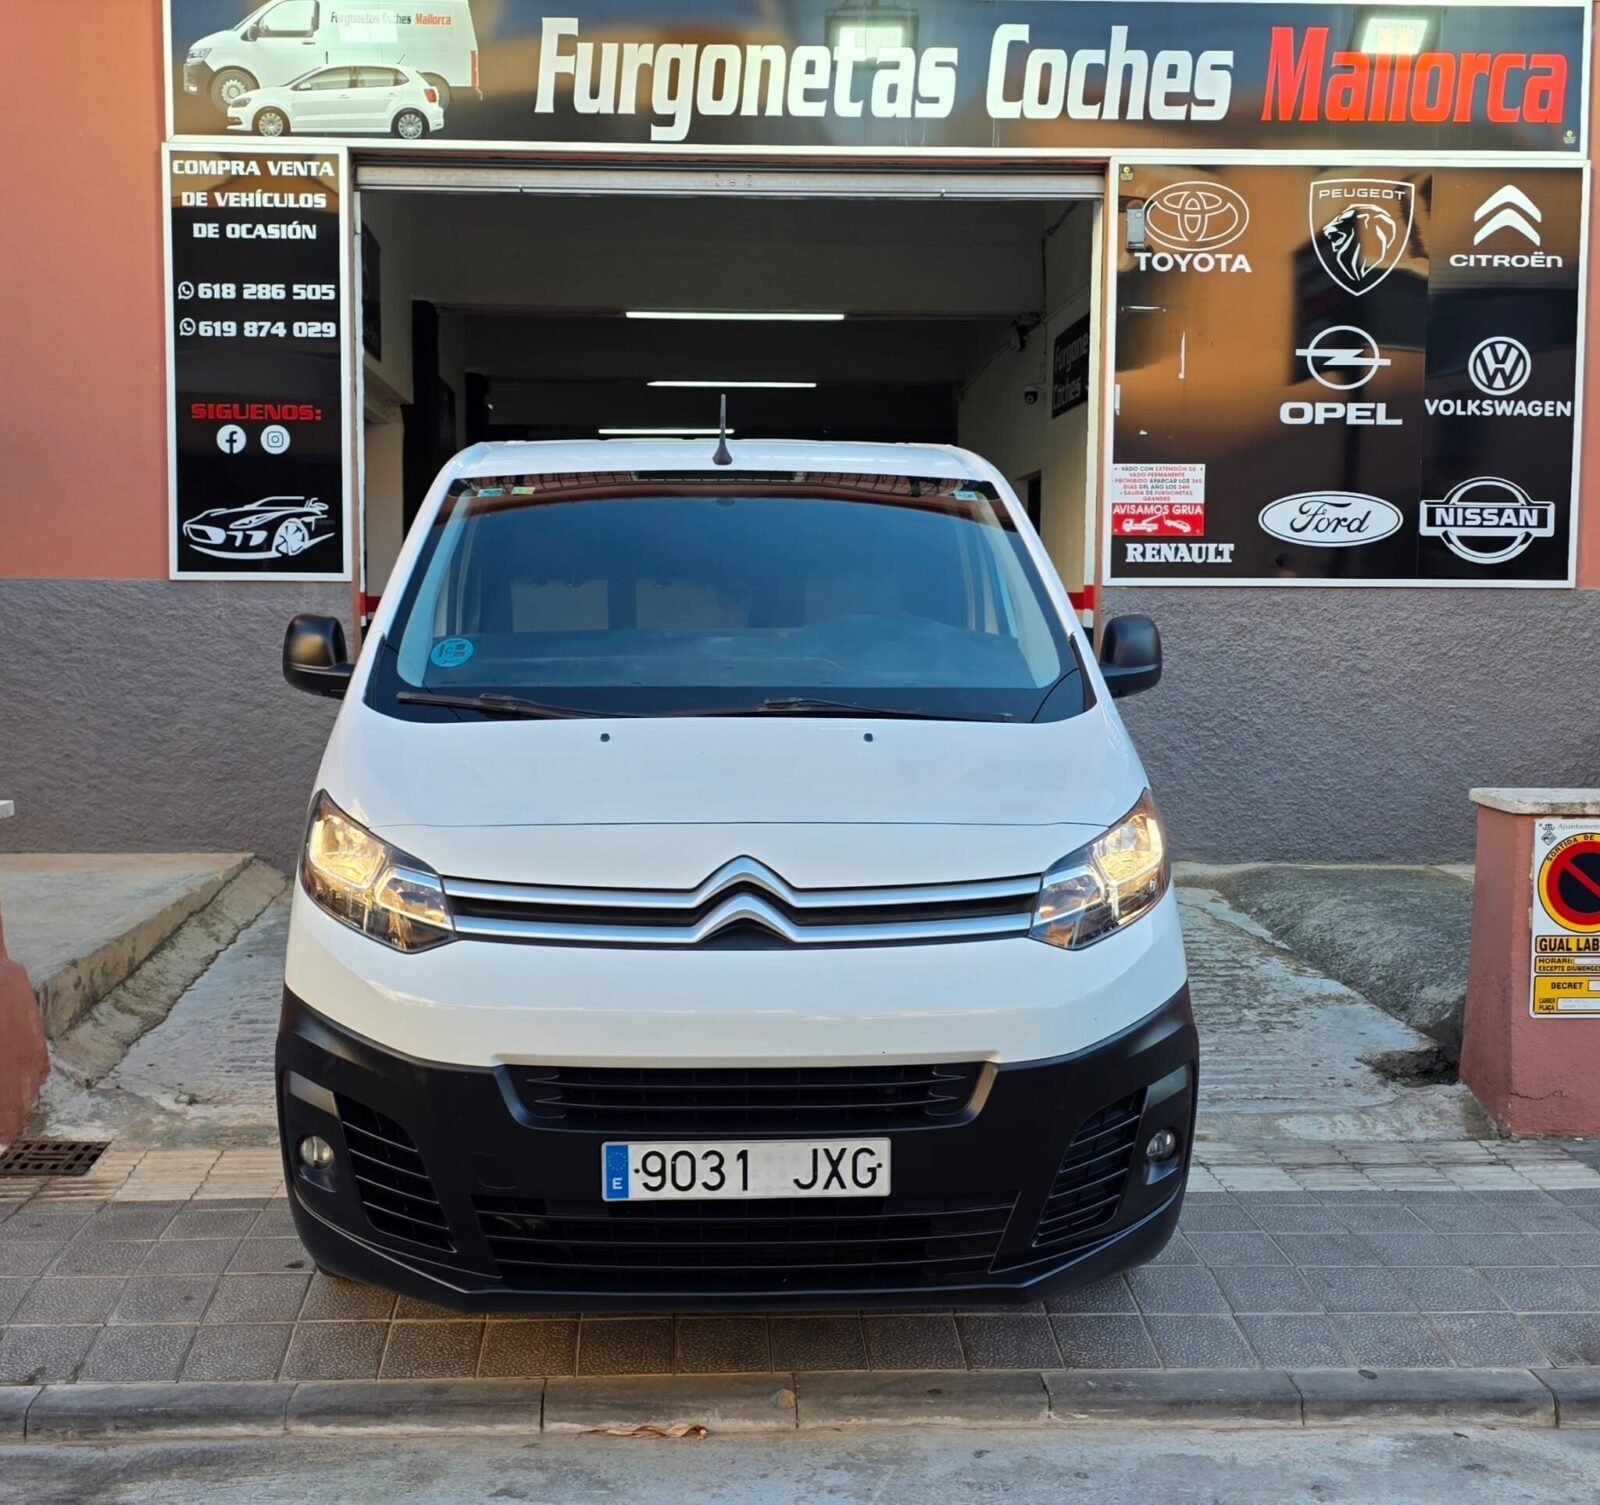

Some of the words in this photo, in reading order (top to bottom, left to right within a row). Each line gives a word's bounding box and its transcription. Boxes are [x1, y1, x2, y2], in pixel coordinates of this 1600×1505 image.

[414, 13, 452, 25] Mallorca
[534, 17, 958, 142] Furgonetas
[986, 24, 1234, 121] Coches
[1260, 26, 1569, 124] Mallorca
[172, 159, 261, 176] COMPRA
[267, 160, 335, 177] VENTA
[181, 191, 208, 207] DE
[214, 188, 327, 208] VEHÍCULOS
[1318, 189, 1406, 201] PEUGEOT
[192, 222, 220, 239] DE
[226, 220, 317, 240] OCASIÓN
[1134, 252, 1252, 274] TOYOTA
[1449, 251, 1564, 269] CITROËN
[197, 283, 237, 300] 618
[243, 283, 286, 300] 286
[292, 284, 336, 301] 505
[198, 320, 237, 337] 619
[243, 321, 287, 338] 874
[293, 321, 337, 338] 029
[191, 403, 323, 421] SIGUENOS:
[1279, 402, 1403, 426] OPEL
[1424, 398, 1573, 418] VOLKSWAGEN
[1113, 504, 1169, 515] AVISAMOS
[1172, 504, 1203, 515] GRUA
[1289, 500, 1372, 534] Ford
[1435, 506, 1539, 527] NISSAN
[1125, 543, 1234, 564] RENAULT
[1546, 837, 1578, 862] SORTIDA
[1539, 938, 1572, 951] GUAL
[1576, 938, 1600, 951] LAB
[1551, 981, 1583, 990] DECRET
[612, 1177, 623, 1190] E
[641, 1149, 749, 1192] 9031
[792, 1147, 878, 1190] JXG
